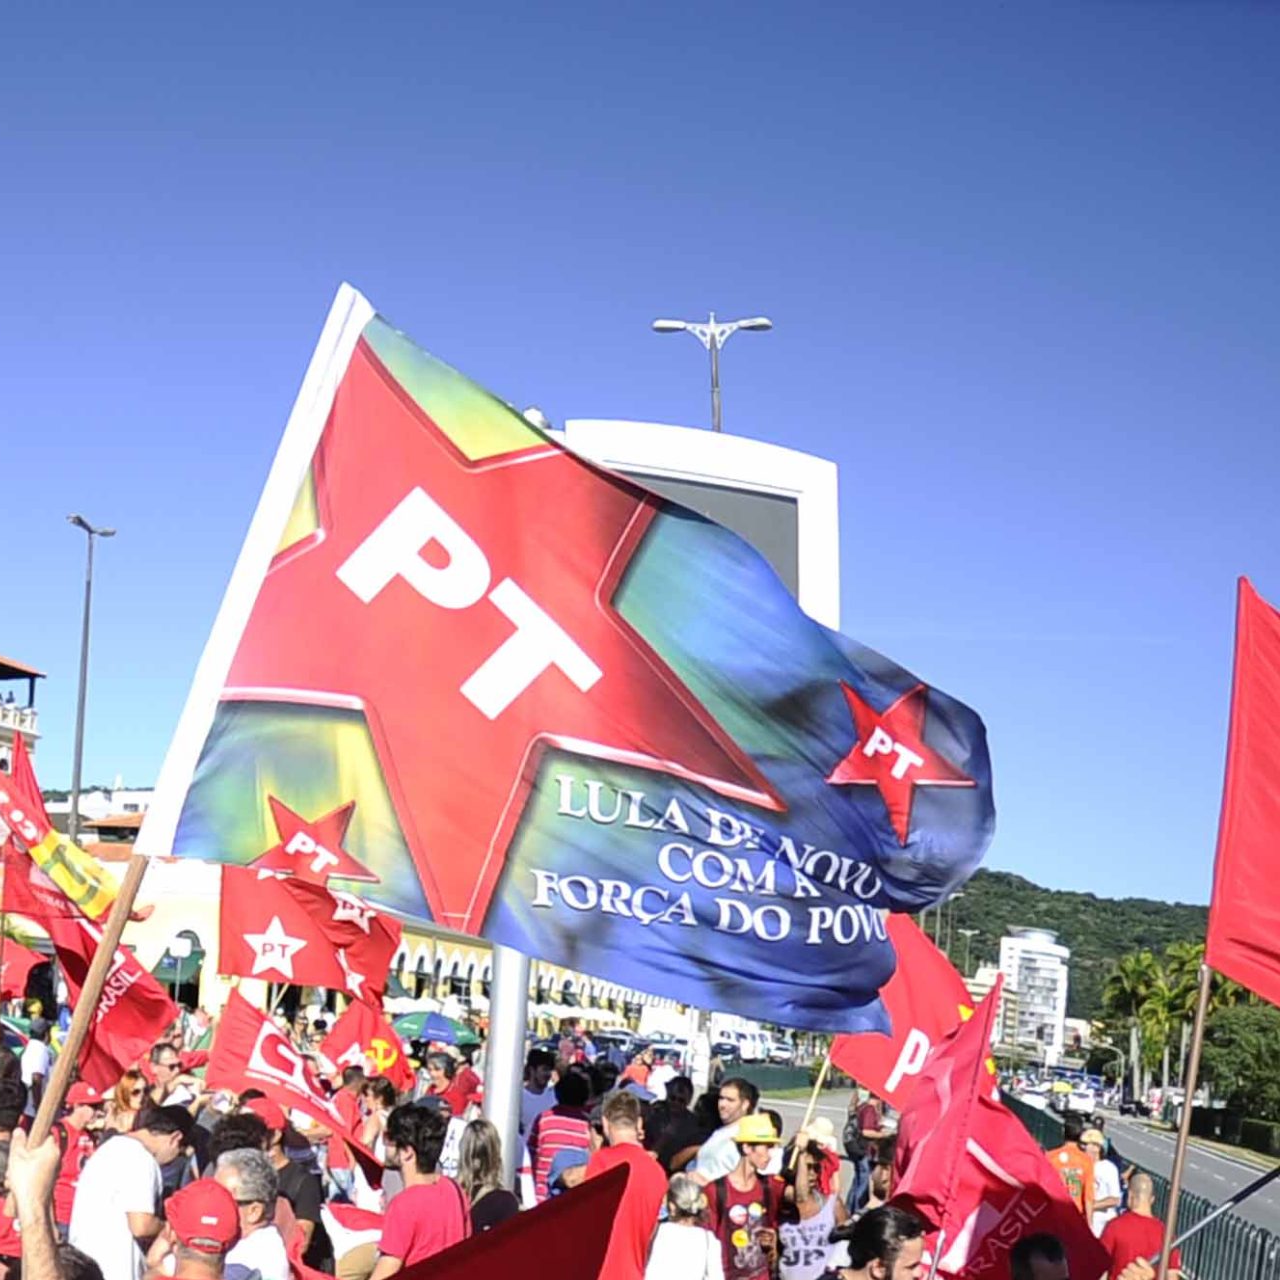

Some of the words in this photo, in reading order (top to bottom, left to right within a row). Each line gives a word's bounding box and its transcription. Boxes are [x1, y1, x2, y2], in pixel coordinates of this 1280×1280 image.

[335, 485, 603, 721] PT
[861, 726, 925, 780] PT
[554, 775, 690, 834] LULA
[284, 830, 340, 873] PT
[658, 842, 778, 897] COM
[793, 868, 822, 898] A
[530, 868, 699, 929] FORÇA
[713, 896, 791, 942] DO
[261, 942, 291, 959] PT
[96, 969, 143, 1024] RASIL
